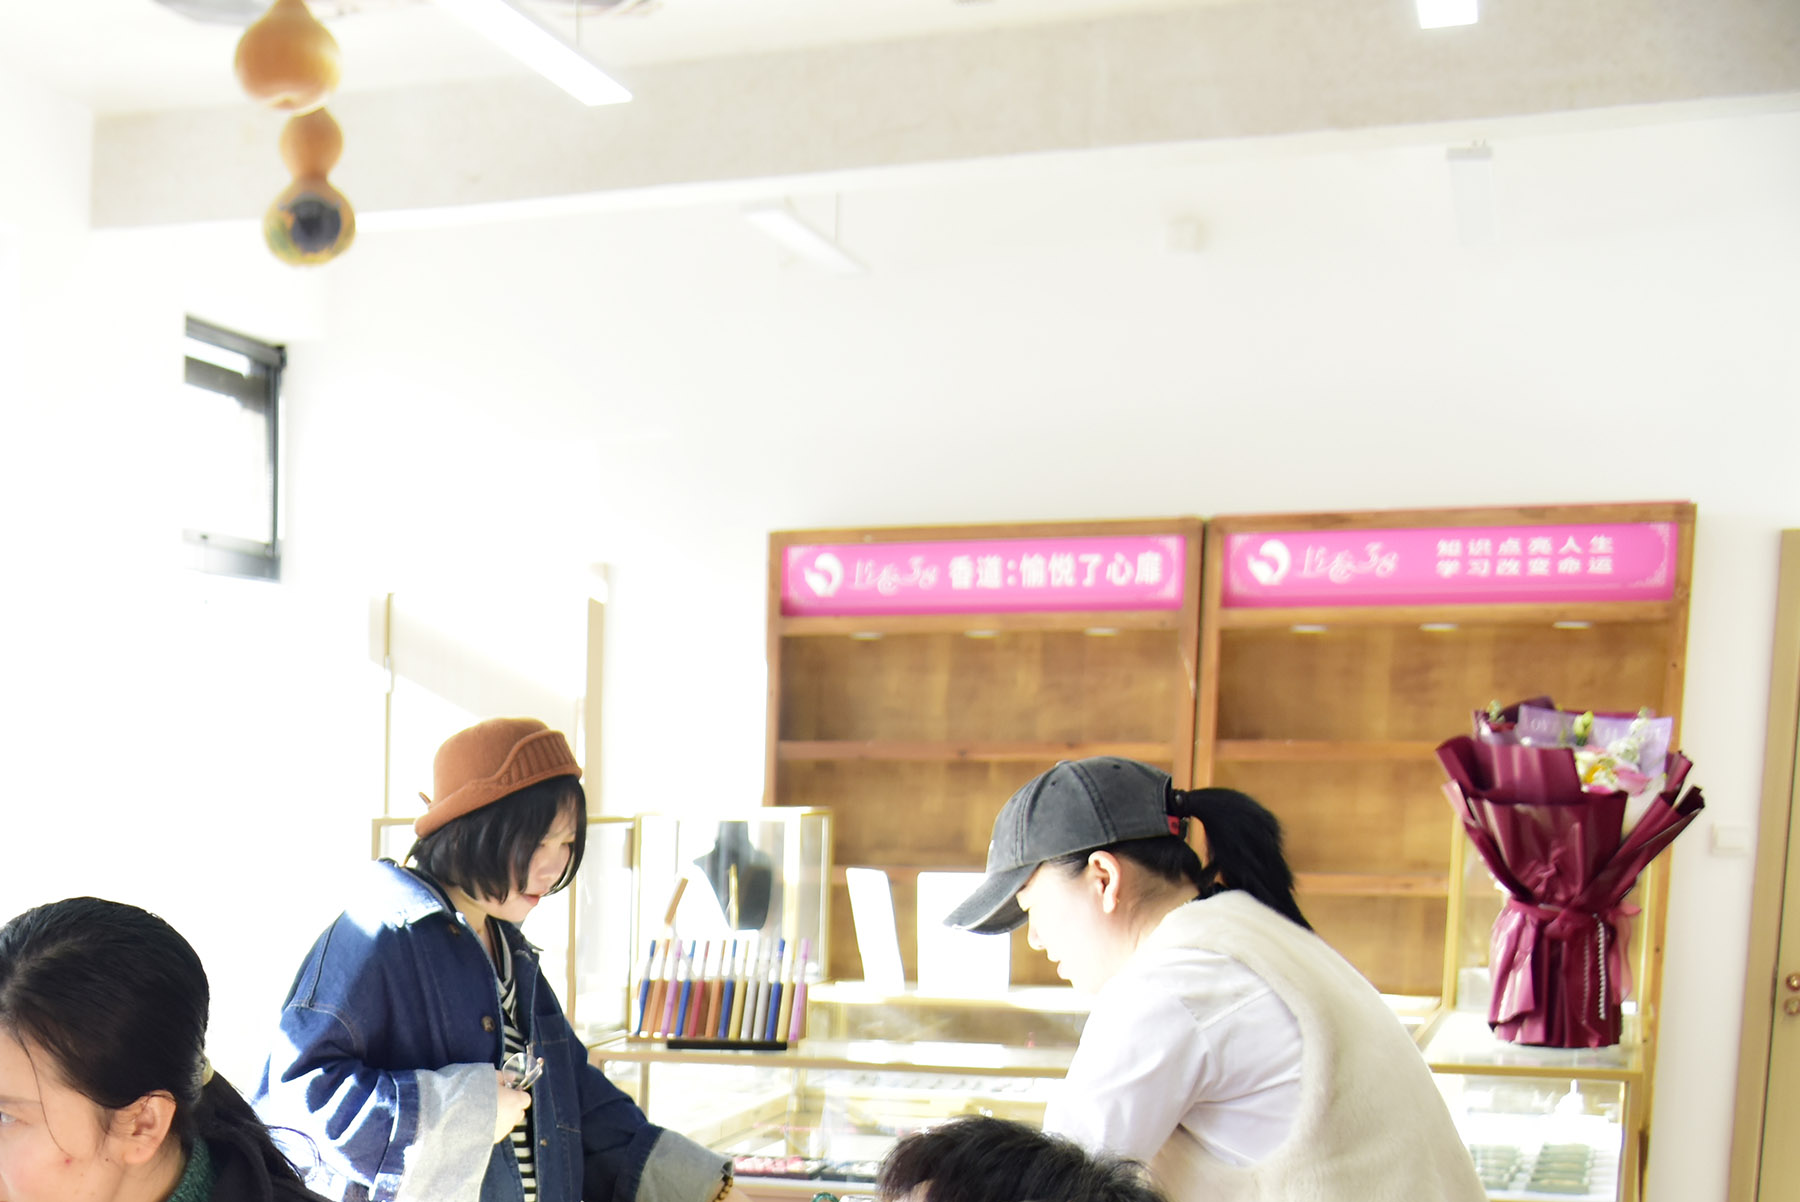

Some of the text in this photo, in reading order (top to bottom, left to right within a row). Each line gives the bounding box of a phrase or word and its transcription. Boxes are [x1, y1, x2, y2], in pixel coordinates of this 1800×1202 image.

[1436, 535, 1614, 558] 知识点亮人生
[1435, 556, 1614, 579] 学习改变命运
